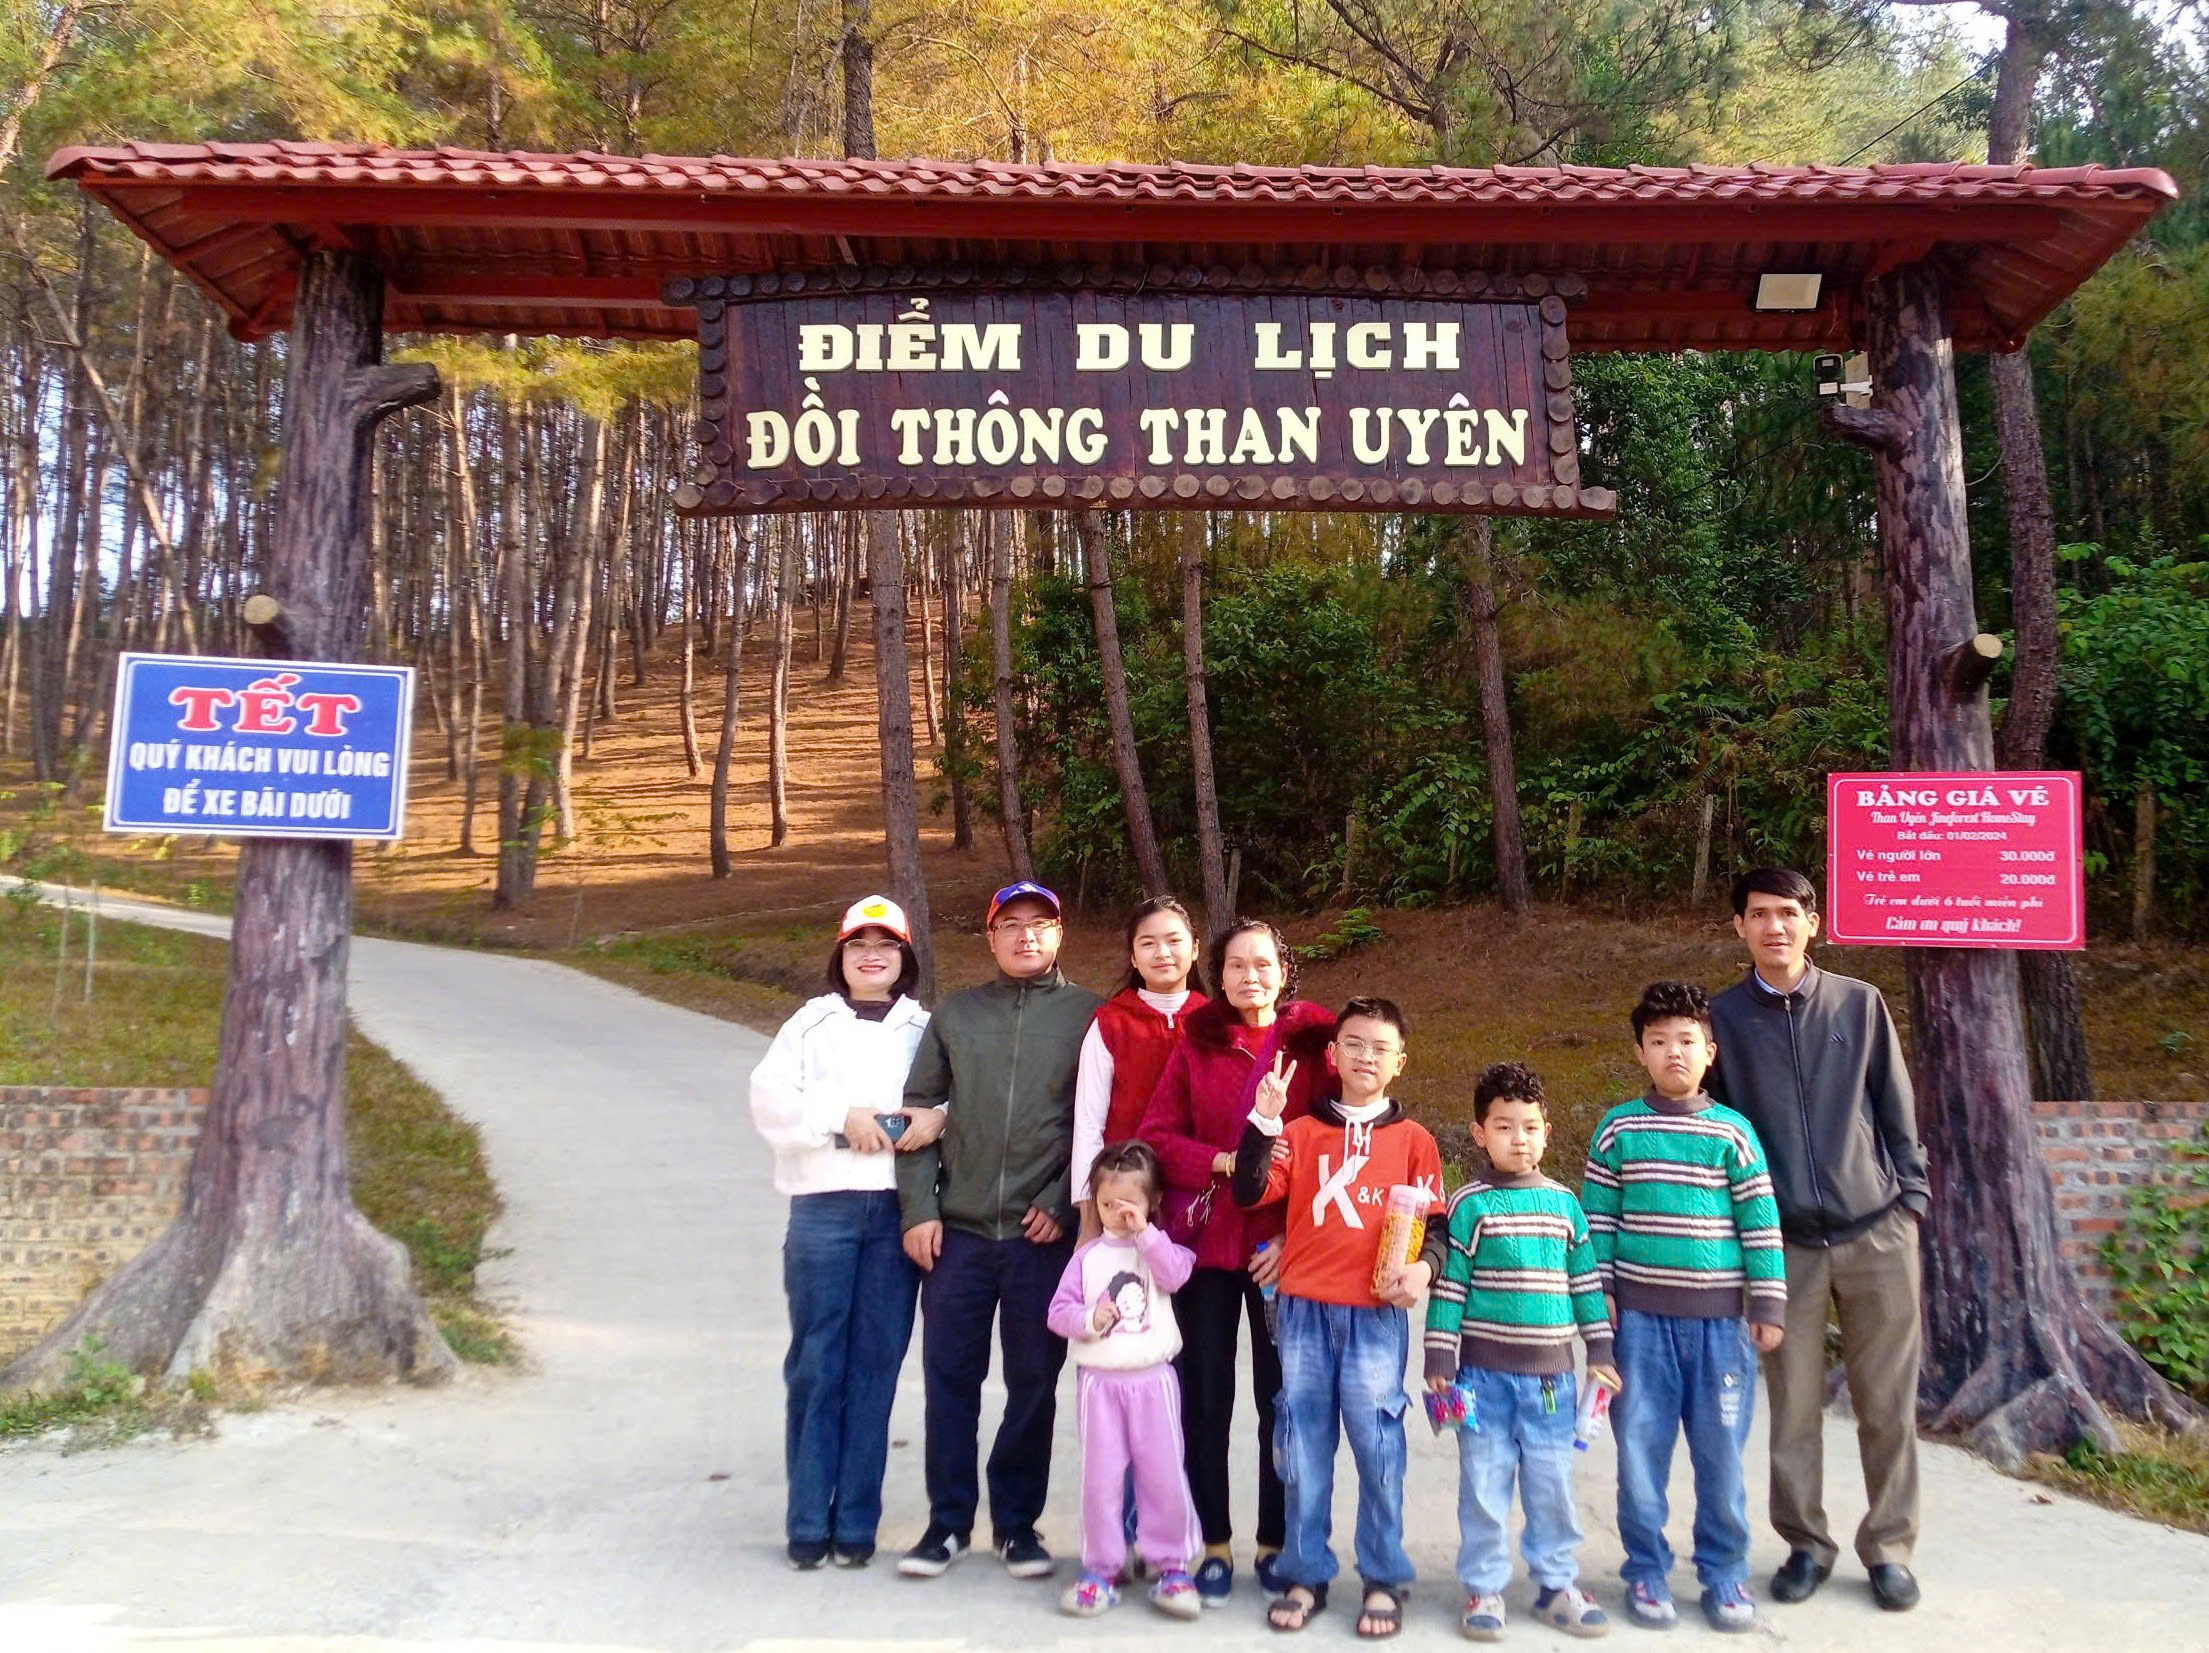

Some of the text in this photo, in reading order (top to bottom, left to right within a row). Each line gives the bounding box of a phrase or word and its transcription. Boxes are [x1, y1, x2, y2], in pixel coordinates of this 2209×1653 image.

[798, 297, 1460, 378] ĐIỂM DU LỊCH
[746, 376, 1529, 468] ĐỒI THÔNG THAN UYÊN
[168, 672, 362, 736] TẾT
[129, 739, 391, 777] QUÝ KHÁCH VUI LÒNG
[163, 778, 353, 820] ĐỂ XE BÃI DƯỚI
[1856, 784, 2050, 807] BẢNG GIÁ VÉ
[1870, 811, 1898, 824] Than
[1856, 849, 2056, 863] Vé người lớn 30.000đ
[1856, 869, 2057, 885] Vé trẻ em 20.000đ
[1943, 896, 1953, 907] 6
